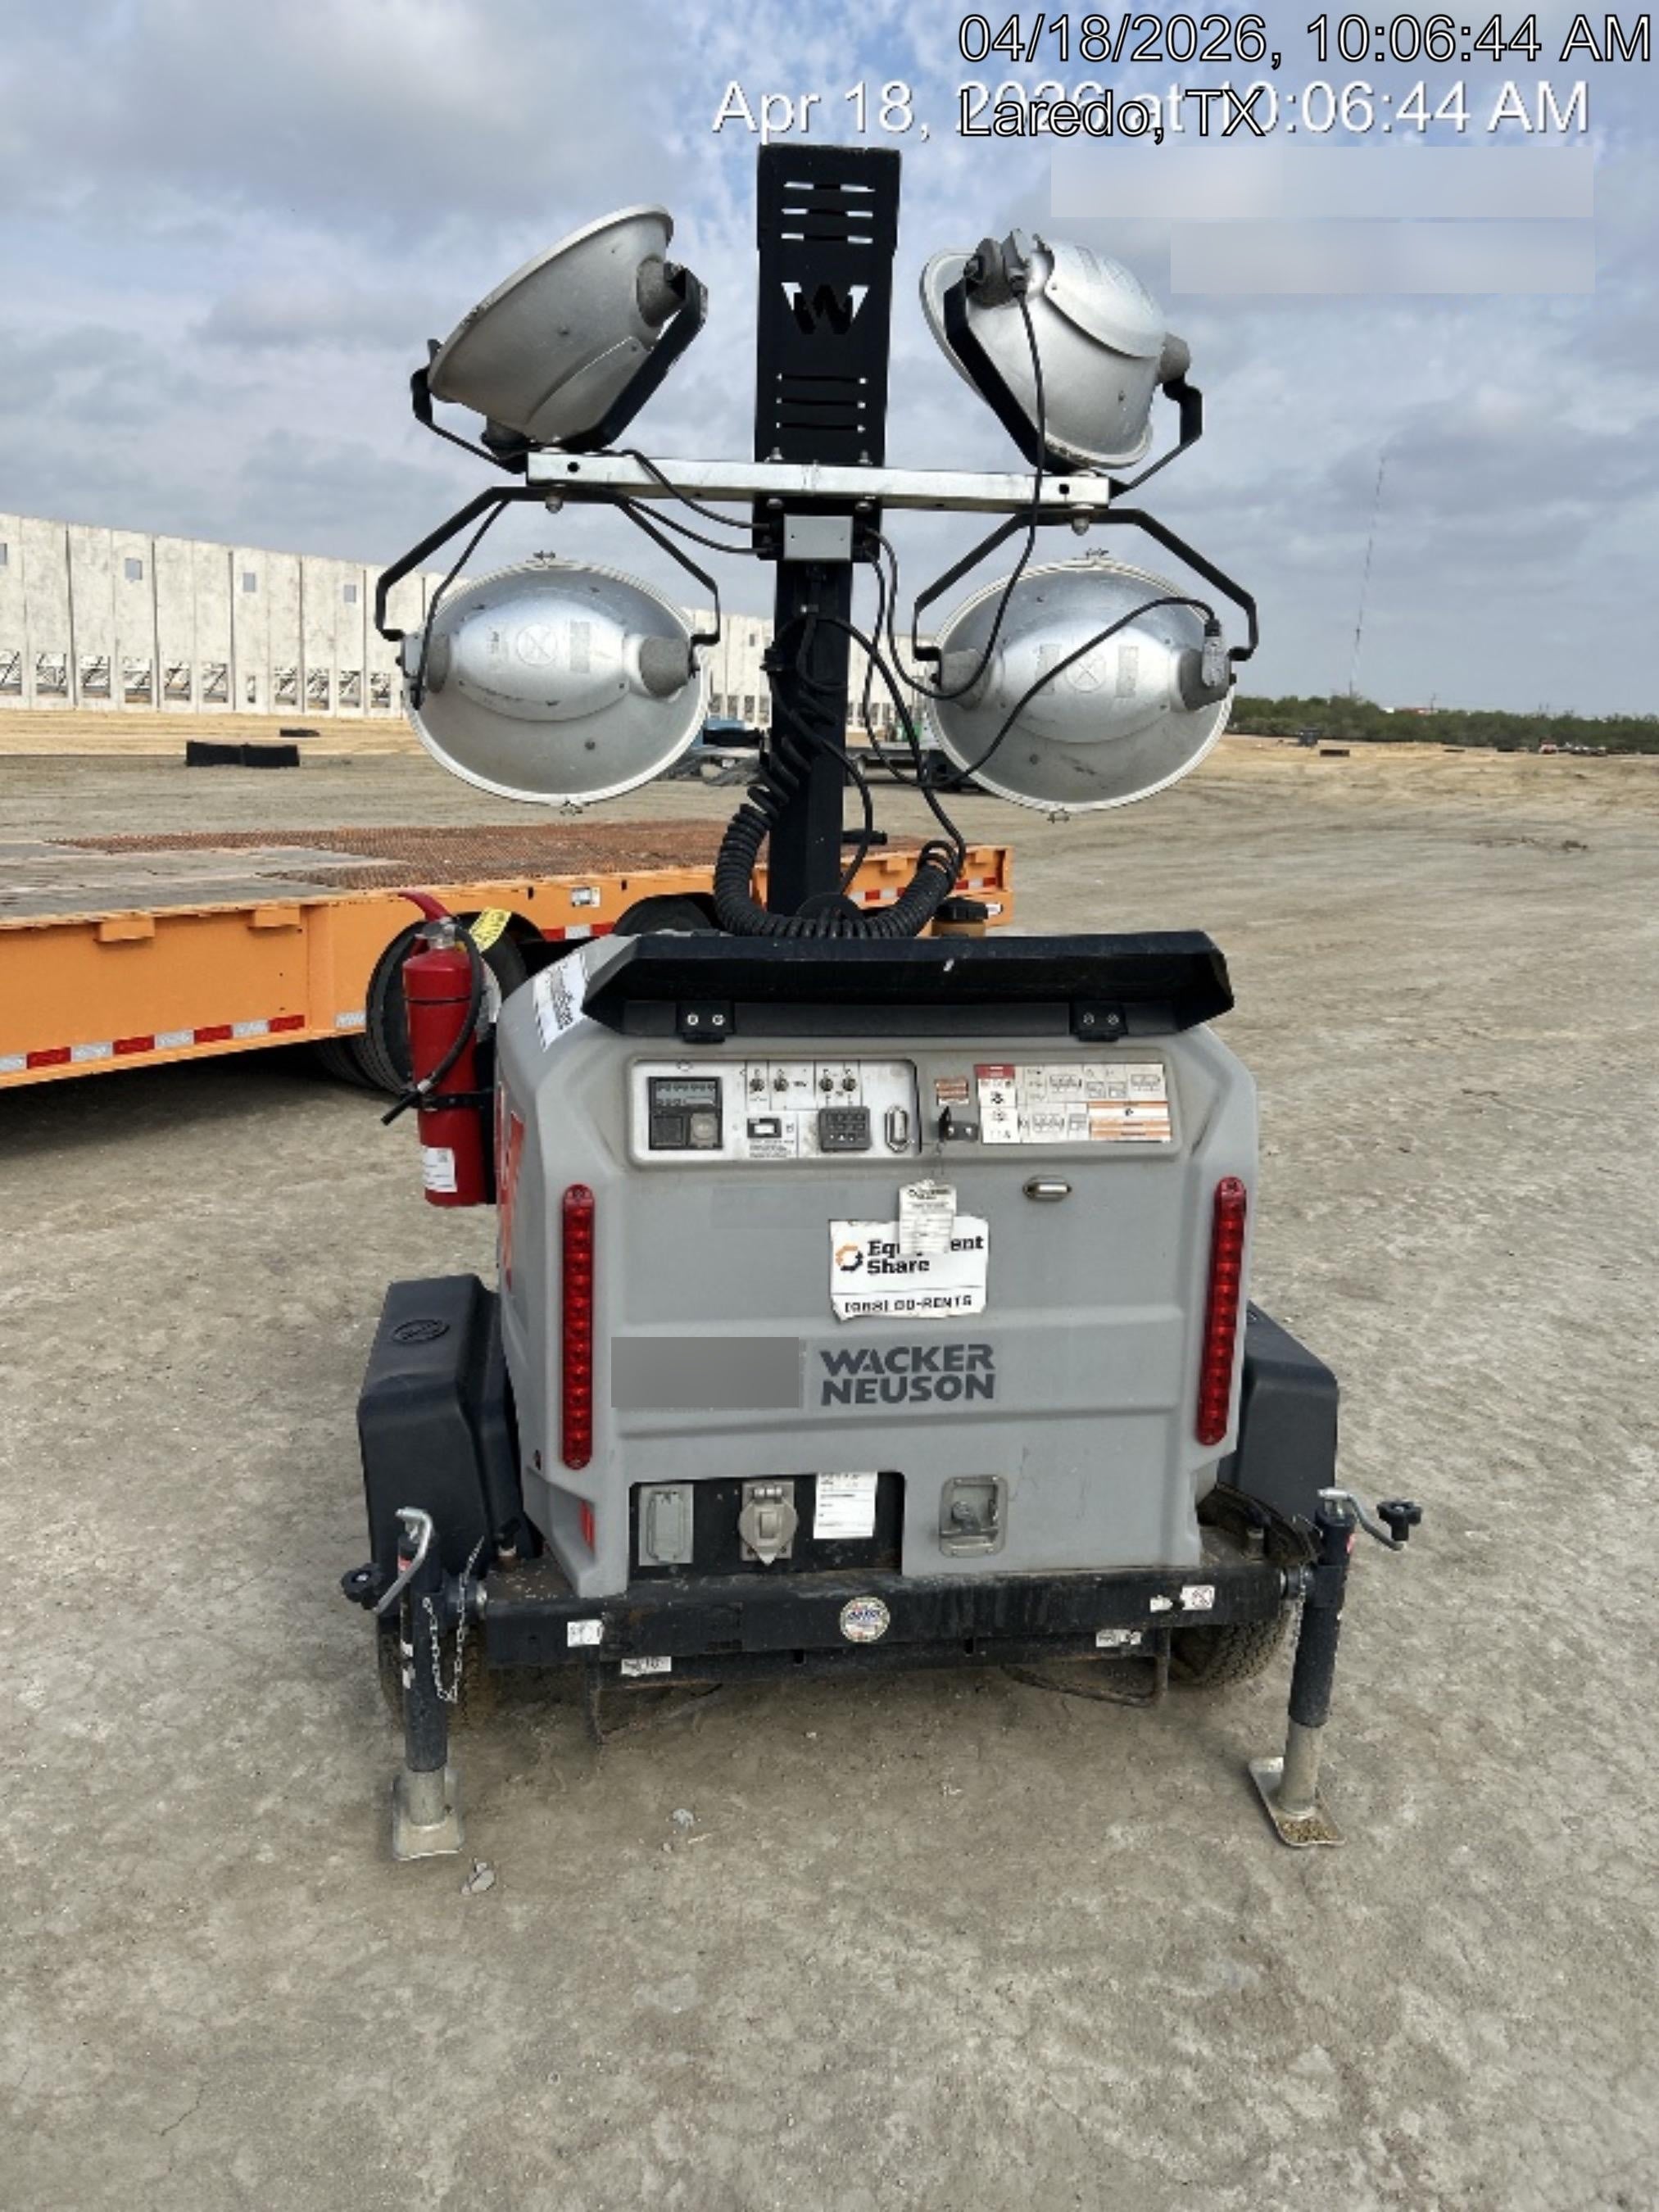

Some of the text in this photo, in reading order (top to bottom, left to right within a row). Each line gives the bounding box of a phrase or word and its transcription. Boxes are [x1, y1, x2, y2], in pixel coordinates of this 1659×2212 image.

[867, 1235, 984, 1259] Eqent
[867, 1259, 931, 1275] Share
[819, 1344, 995, 1375] WACKER
[820, 1374, 995, 1406] NEUSON
